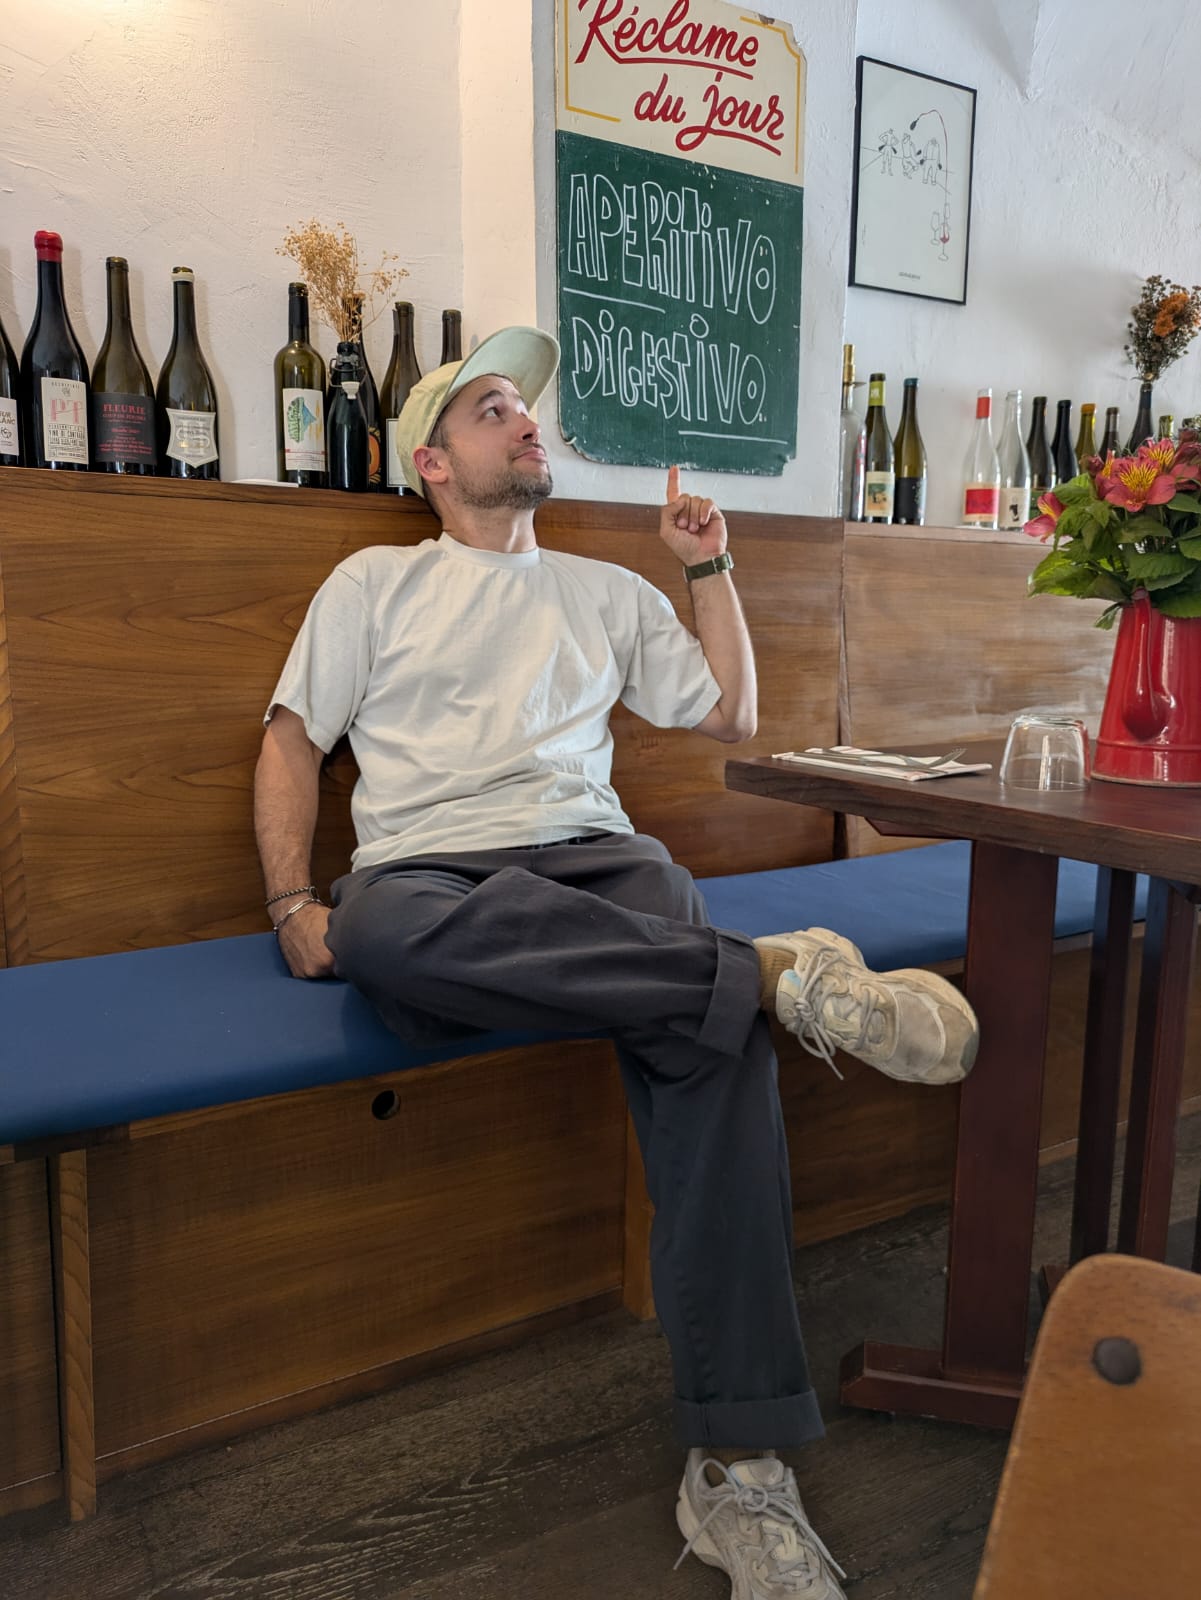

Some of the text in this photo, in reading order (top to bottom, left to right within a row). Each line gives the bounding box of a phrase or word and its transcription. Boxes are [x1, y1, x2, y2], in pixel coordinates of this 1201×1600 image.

[575, 0, 758, 70] Réclame
[634, 71, 785, 156] du jour
